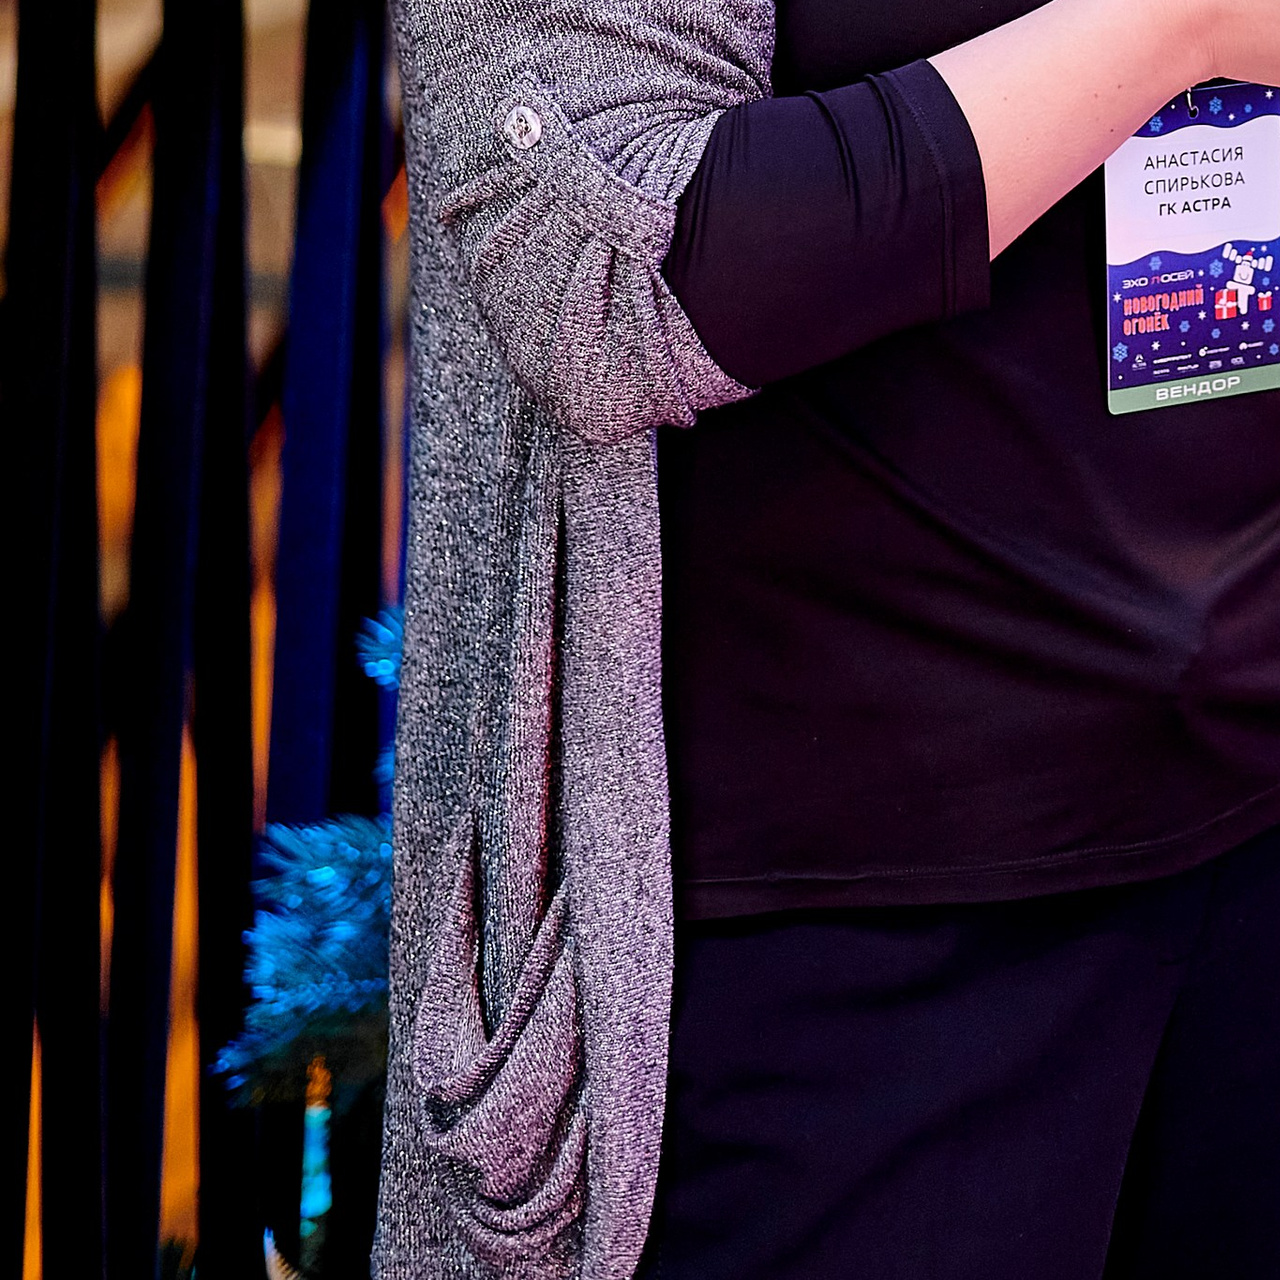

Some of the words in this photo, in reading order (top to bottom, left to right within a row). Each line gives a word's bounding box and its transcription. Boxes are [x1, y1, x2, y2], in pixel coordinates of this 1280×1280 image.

[1144, 146, 1244, 170] АНАСТАСИЯ
[1144, 171, 1245, 195] СПИРЬКОВА
[1159, 202, 1177, 216] ГК
[1181, 196, 1231, 214] АСТРА
[1122, 277, 1149, 289] ЭХО
[1123, 283, 1204, 316] НОВОГОДНИЙ
[1123, 311, 1170, 336] ОГОНЁК
[1156, 376, 1241, 401] ВЕНДОР
